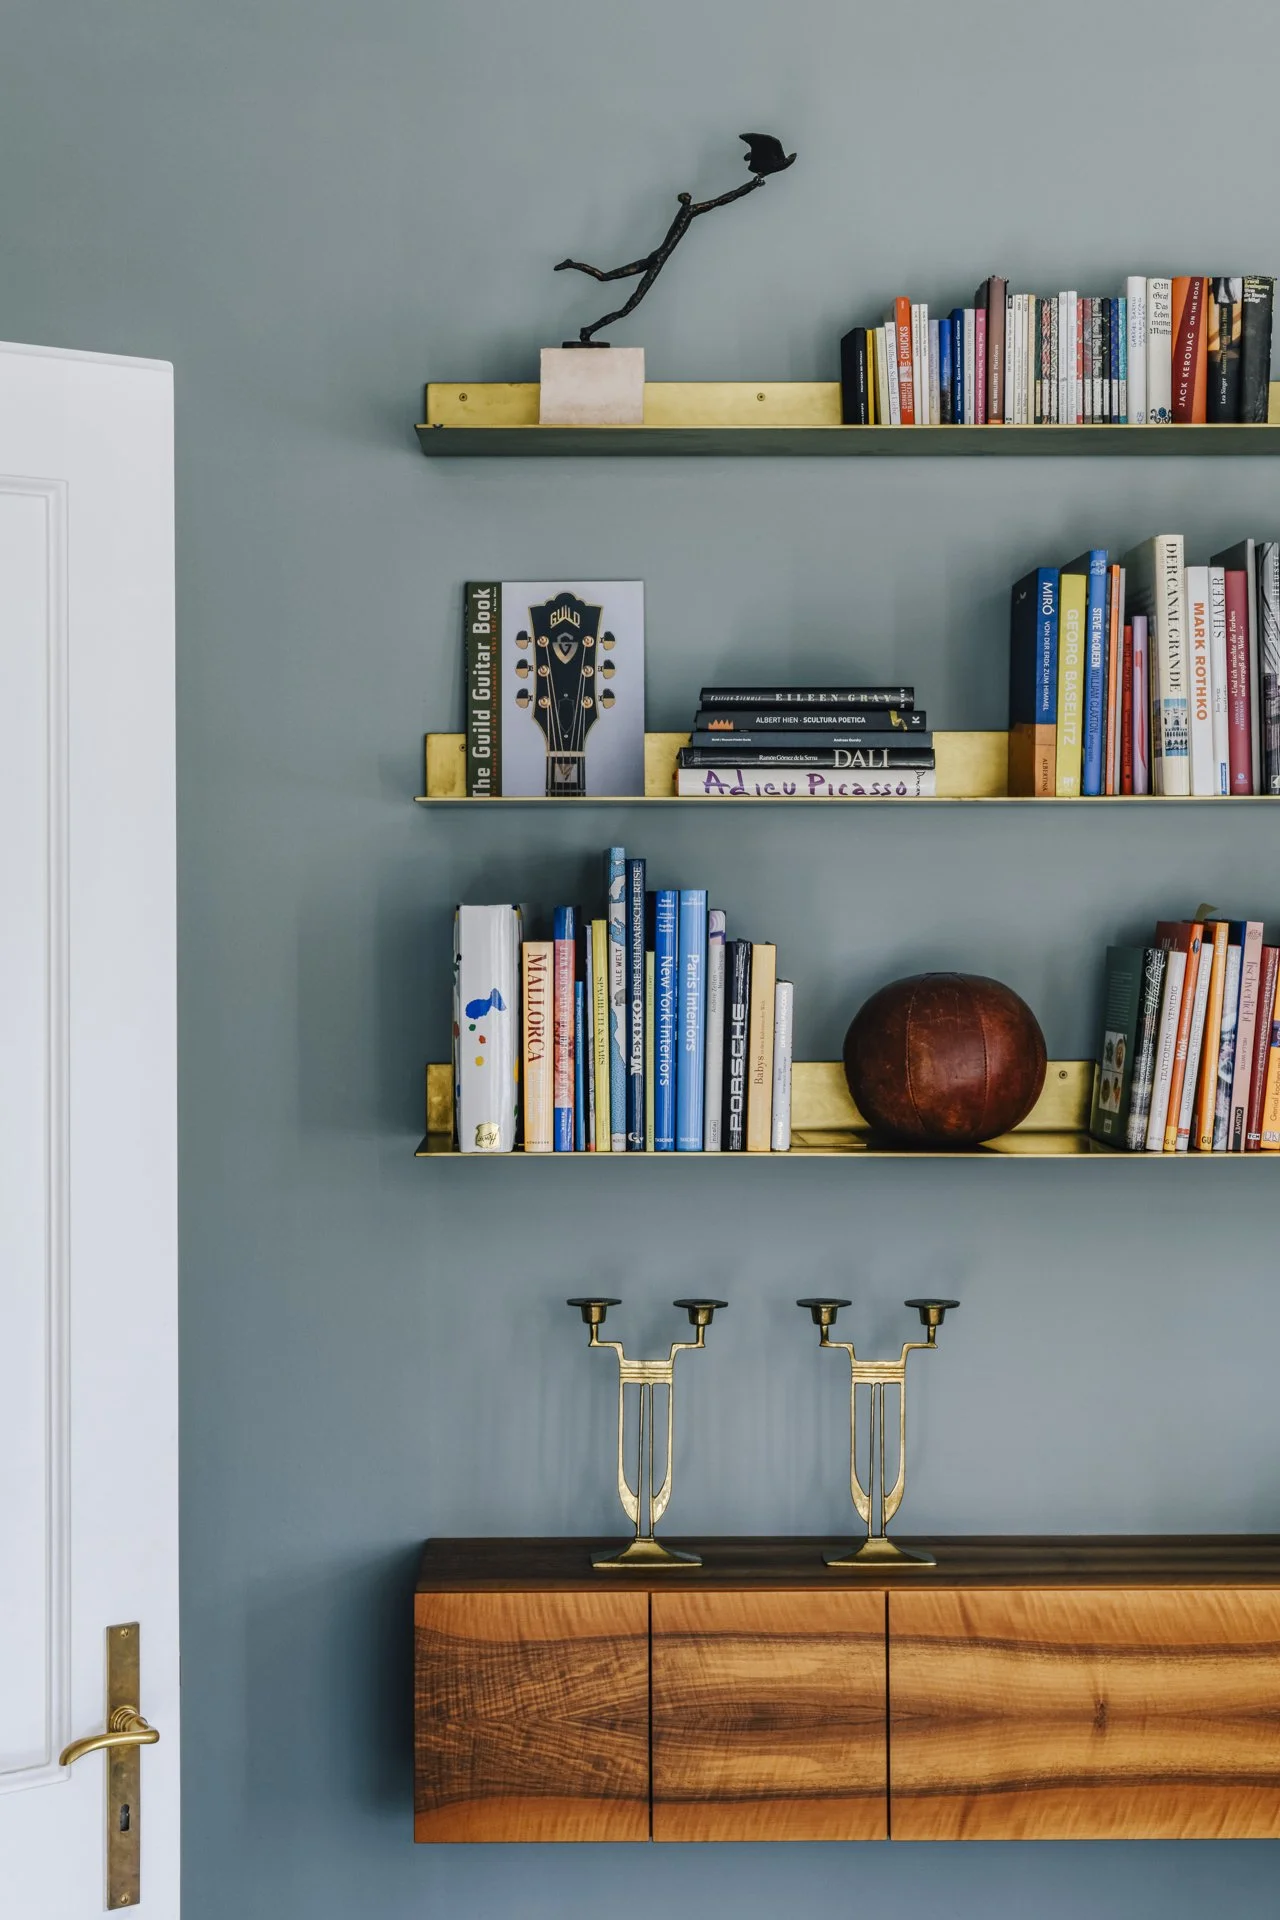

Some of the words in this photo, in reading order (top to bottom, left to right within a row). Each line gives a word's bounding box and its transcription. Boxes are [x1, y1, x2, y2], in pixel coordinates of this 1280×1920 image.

[1155, 302, 1168, 310] Das
[1189, 315, 1196, 326] ON
[899, 326, 910, 360] CHUCKS
[1182, 332, 1194, 378] KEROUAC
[1179, 382, 1188, 407] JACK
[1220, 378, 1228, 394] Singer
[1166, 543, 1178, 574] DER
[472, 587, 490, 634] Book
[1042, 582, 1055, 615] MIRÓ
[1167, 577, 1180, 626] CANAL
[1212, 577, 1225, 638] SHAKER
[550, 605, 581, 628] GUILD
[1092, 607, 1102, 630] STEVE
[1194, 602, 1205, 650] MARK
[1228, 611, 1236, 632] Farben
[1065, 609, 1079, 665] GEORG
[1091, 631, 1101, 668] McQUEEN
[1168, 628, 1181, 693] GRANDE
[1237, 651, 1245, 660] die
[472, 643, 490, 701] Guitar
[1090, 668, 1100, 698] WILLIAM
[775, 693, 839, 702] EILEEN
[847, 694, 892, 702] GRAY
[1195, 655, 1208, 721] ROTHKO
[912, 716, 921, 724] K
[1063, 671, 1078, 745] BASELITZ
[1090, 701, 1099, 733] CLAXTON
[472, 710, 490, 758] Guild
[472, 767, 490, 797] The
[702, 769, 797, 797] Adieu
[806, 773, 907, 797] Picasso
[633, 866, 641, 893] REISE
[633, 896, 641, 970] KULINARISCHE
[560, 945, 568, 970] WELT
[660, 956, 673, 987] New
[686, 954, 698, 989] Paris
[560, 970, 568, 985] DER
[633, 972, 641, 996] EINE
[527, 953, 547, 1063] MALLORCA
[560, 986, 568, 1009] ATLAS
[659, 991, 673, 1021] York
[686, 992, 699, 1052] Interiors
[1161, 1034, 1171, 1081] TRATTORIEN
[1168, 985, 1178, 1021] VENEDIG
[597, 1038, 605, 1066] STARS
[630, 1000, 643, 1076] MEXIKO
[1176, 1038, 1187, 1061] Wok
[659, 1025, 673, 1086] Interiors
[730, 1003, 744, 1131] PORSCHE
[754, 1055, 767, 1085] Babys
[1271, 1071, 1280, 1096] kochen
[1270, 1097, 1279, 1121] Genial
[1202, 1136, 1212, 1144] GU
